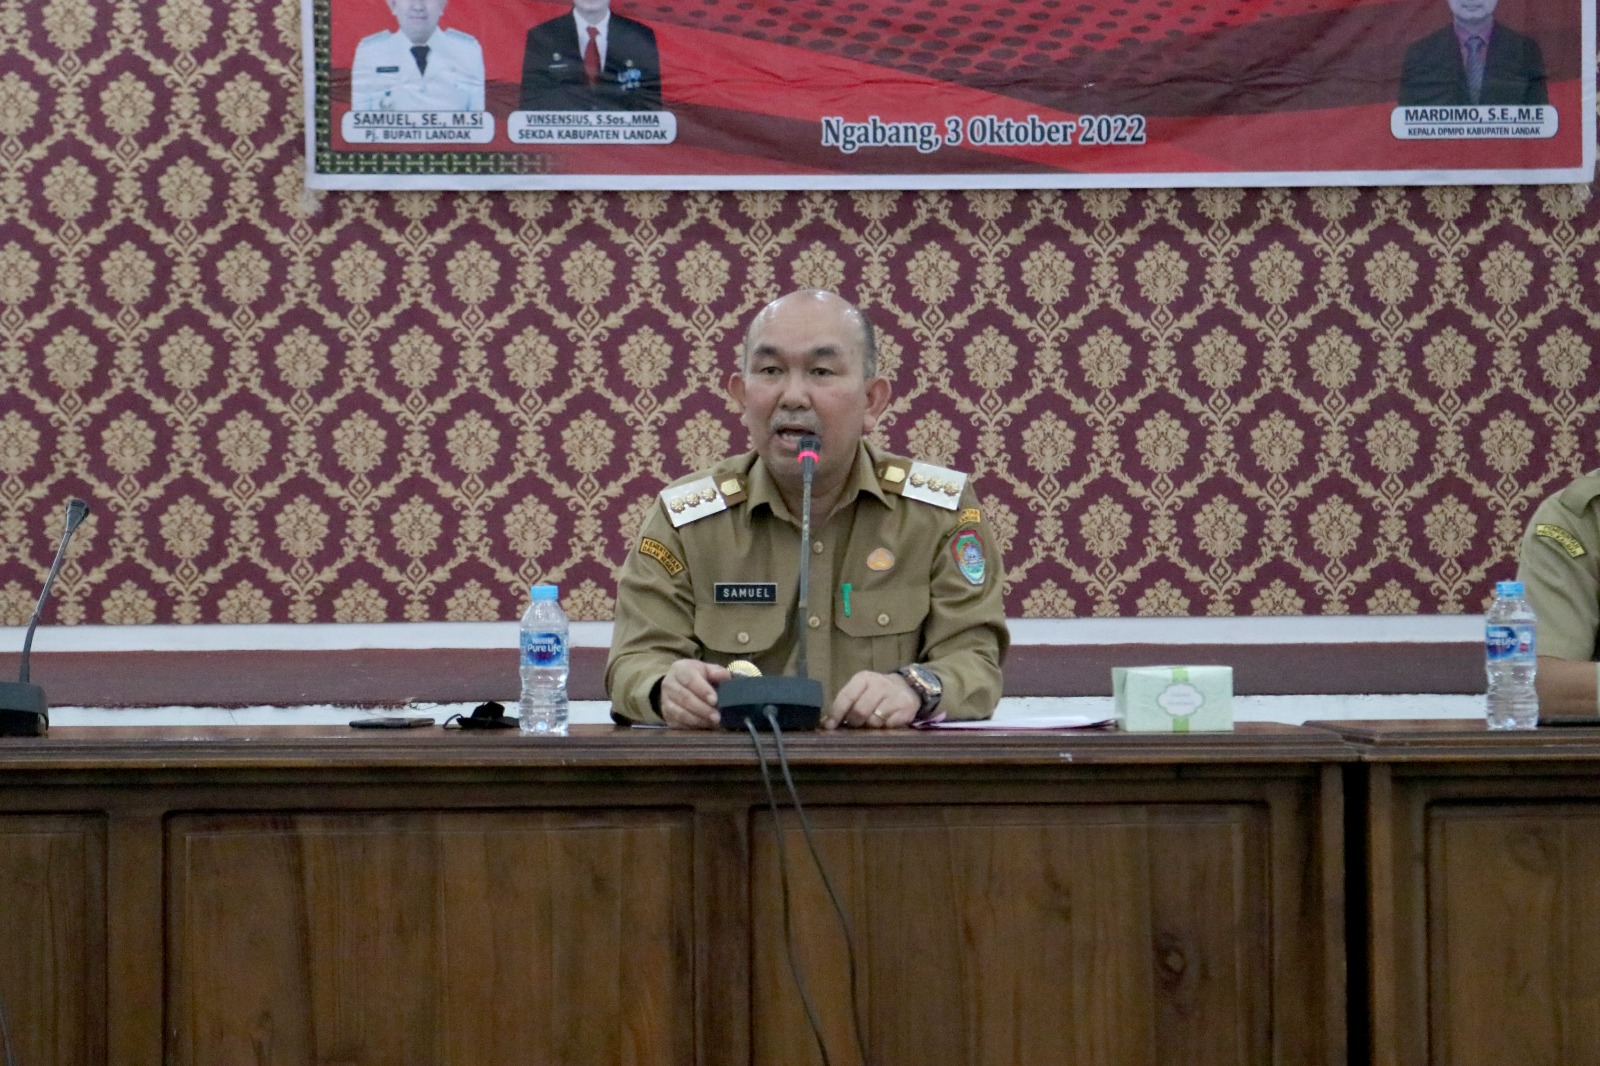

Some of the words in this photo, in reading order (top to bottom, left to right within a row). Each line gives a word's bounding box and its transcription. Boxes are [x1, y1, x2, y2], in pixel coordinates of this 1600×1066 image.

[353, 112, 416, 128] SAMUEL,
[421, 112, 447, 128] SE.,
[452, 112, 483, 125] M.Si
[526, 114, 593, 126] VINSENSIUS,
[1405, 108, 1483, 123] MARDIMO,
[383, 130, 422, 140] BUPATI
[425, 130, 471, 140] LANDAK
[518, 129, 554, 140] SEKDA
[557, 129, 620, 140] KABUPATEN
[623, 129, 667, 140] LANDAK
[822, 116, 942, 151] Ngabang,
[946, 116, 962, 145] 3
[968, 115, 1074, 145] Oktober
[1079, 115, 1146, 144] 2022
[1408, 126, 1436, 136] KEPALA
[1467, 126, 1510, 136] KABUPATEN
[1512, 125, 1541, 136] LANDAK
[723, 588, 770, 598] SAMUEL
[527, 644, 547, 653] Pure
[547, 643, 562, 656] Life
